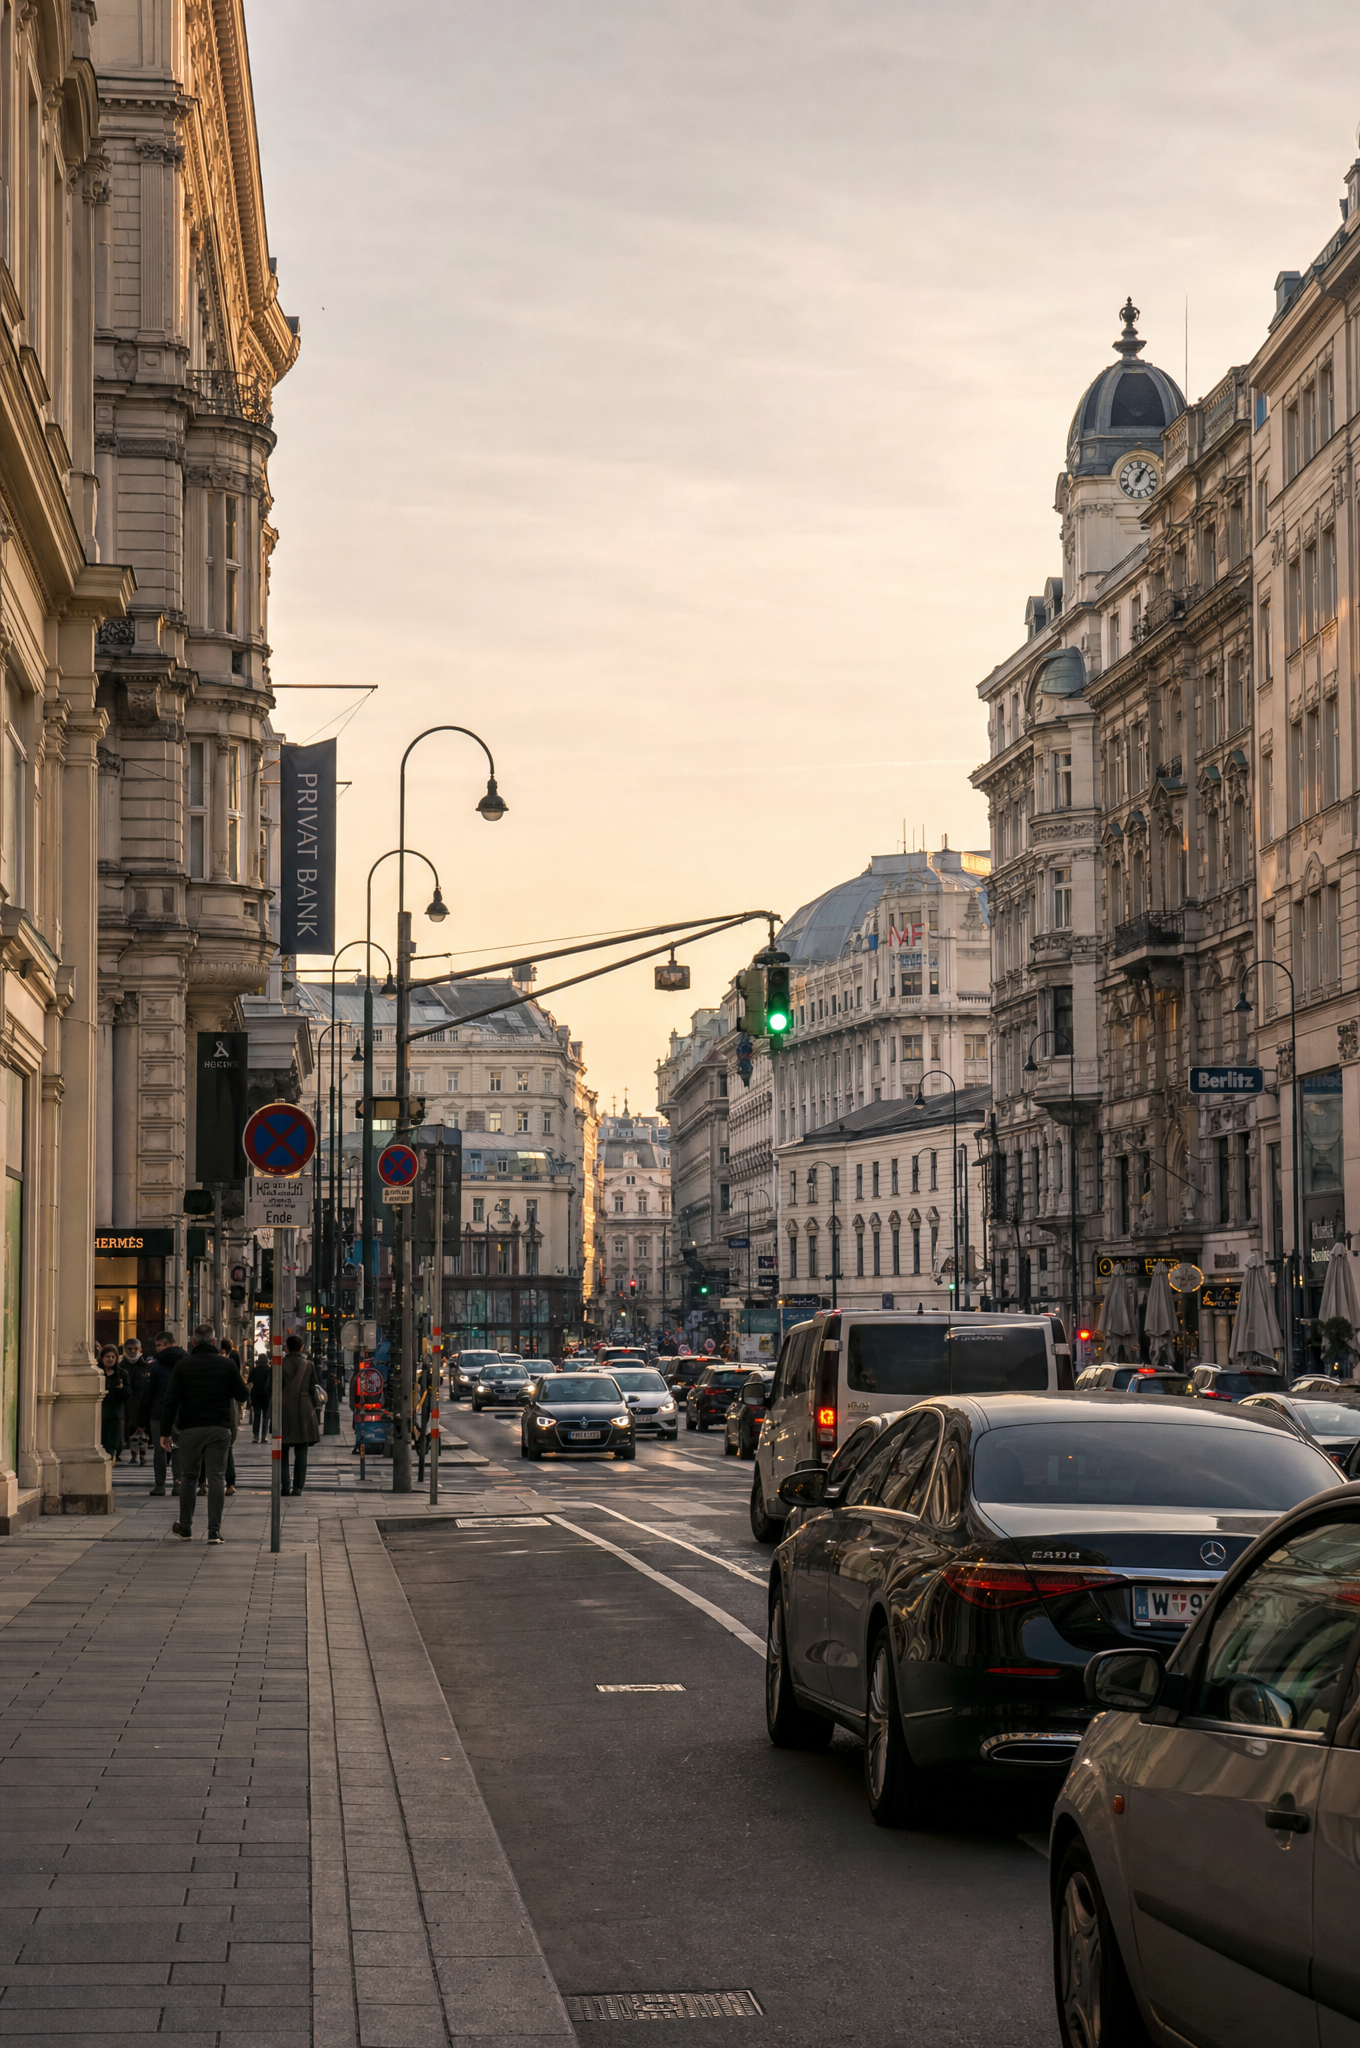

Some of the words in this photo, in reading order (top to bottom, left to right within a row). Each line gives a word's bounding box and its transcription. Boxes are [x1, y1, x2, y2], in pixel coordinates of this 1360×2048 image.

[297, 774, 318, 860] PRIVAT
[297, 869, 318, 937] BANK
[1198, 1071, 1254, 1088] Berlitz
[266, 1211, 292, 1223] Ende
[1152, 1593, 1169, 1615] W
